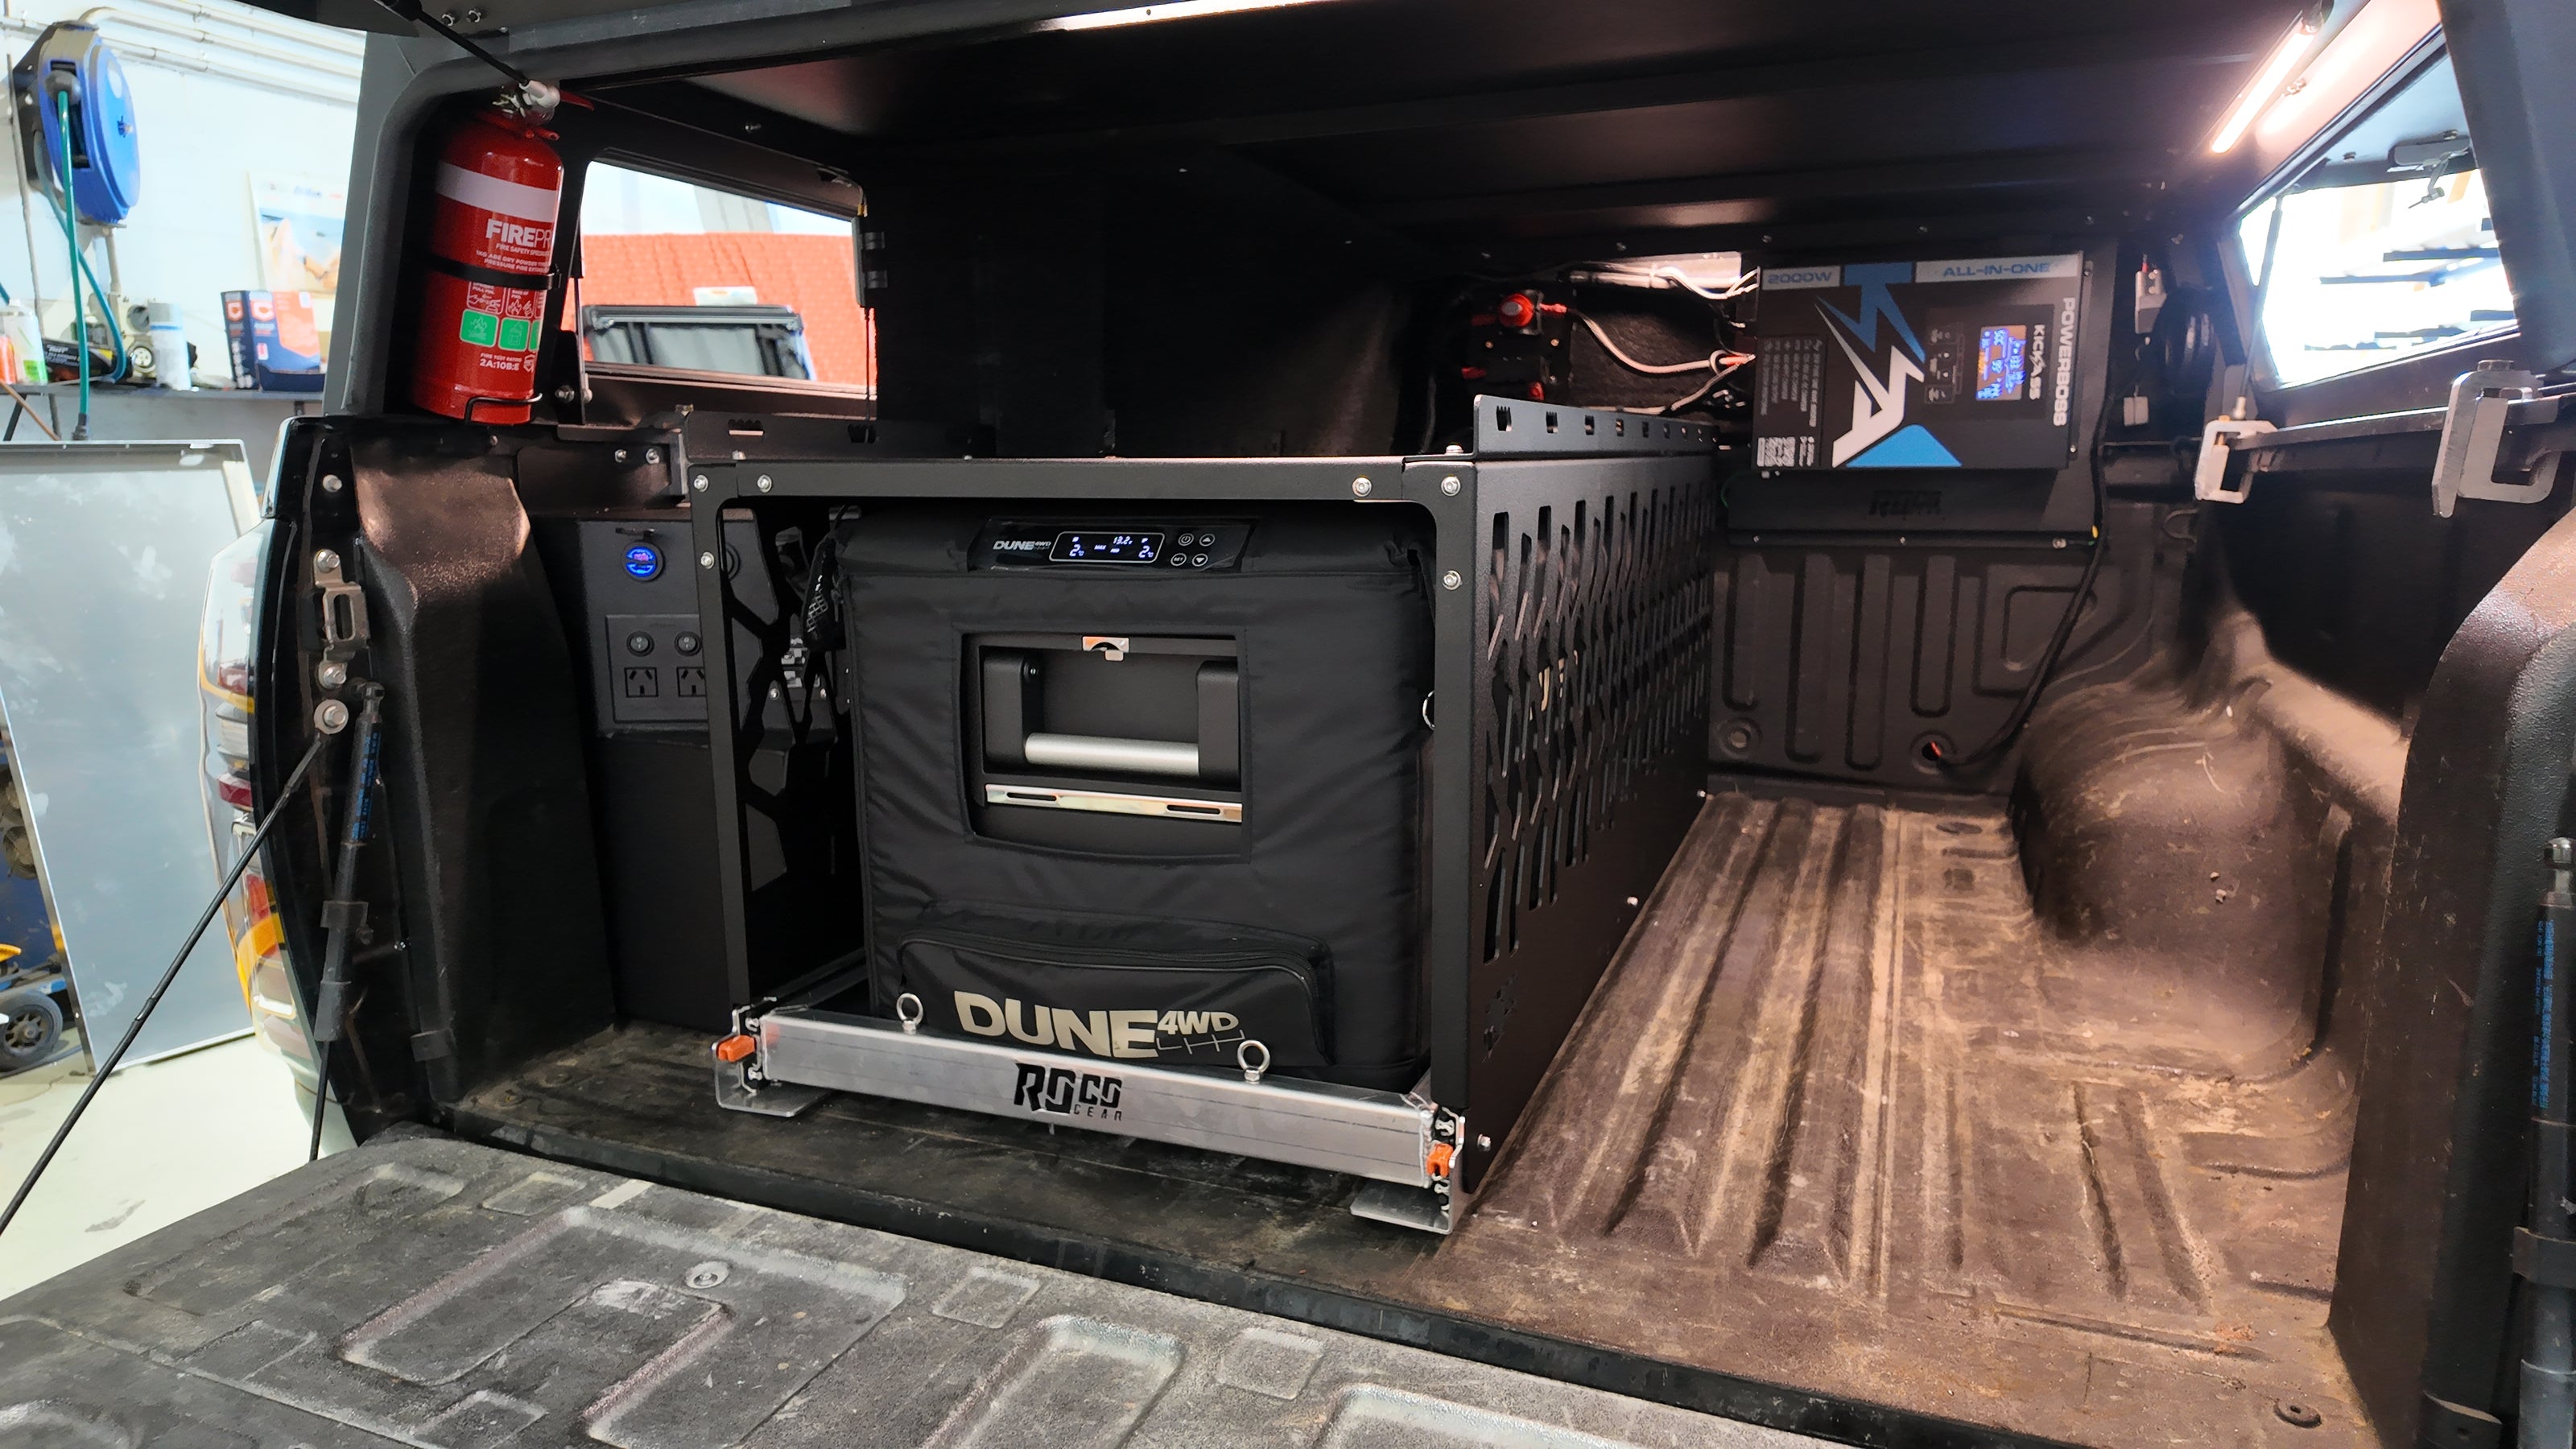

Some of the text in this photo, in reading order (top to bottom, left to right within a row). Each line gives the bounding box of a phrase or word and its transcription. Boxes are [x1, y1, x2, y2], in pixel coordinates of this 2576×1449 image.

[1768, 270, 1832, 287] 2000W
[1942, 262, 2051, 279] ALL-IN-ONE
[2053, 297, 2076, 427] POWERBOSS
[993, 540, 1035, 551] DUNE
[954, 991, 1240, 1059] DUNE 4WD
[1073, 1104, 1122, 1121] GEAR
